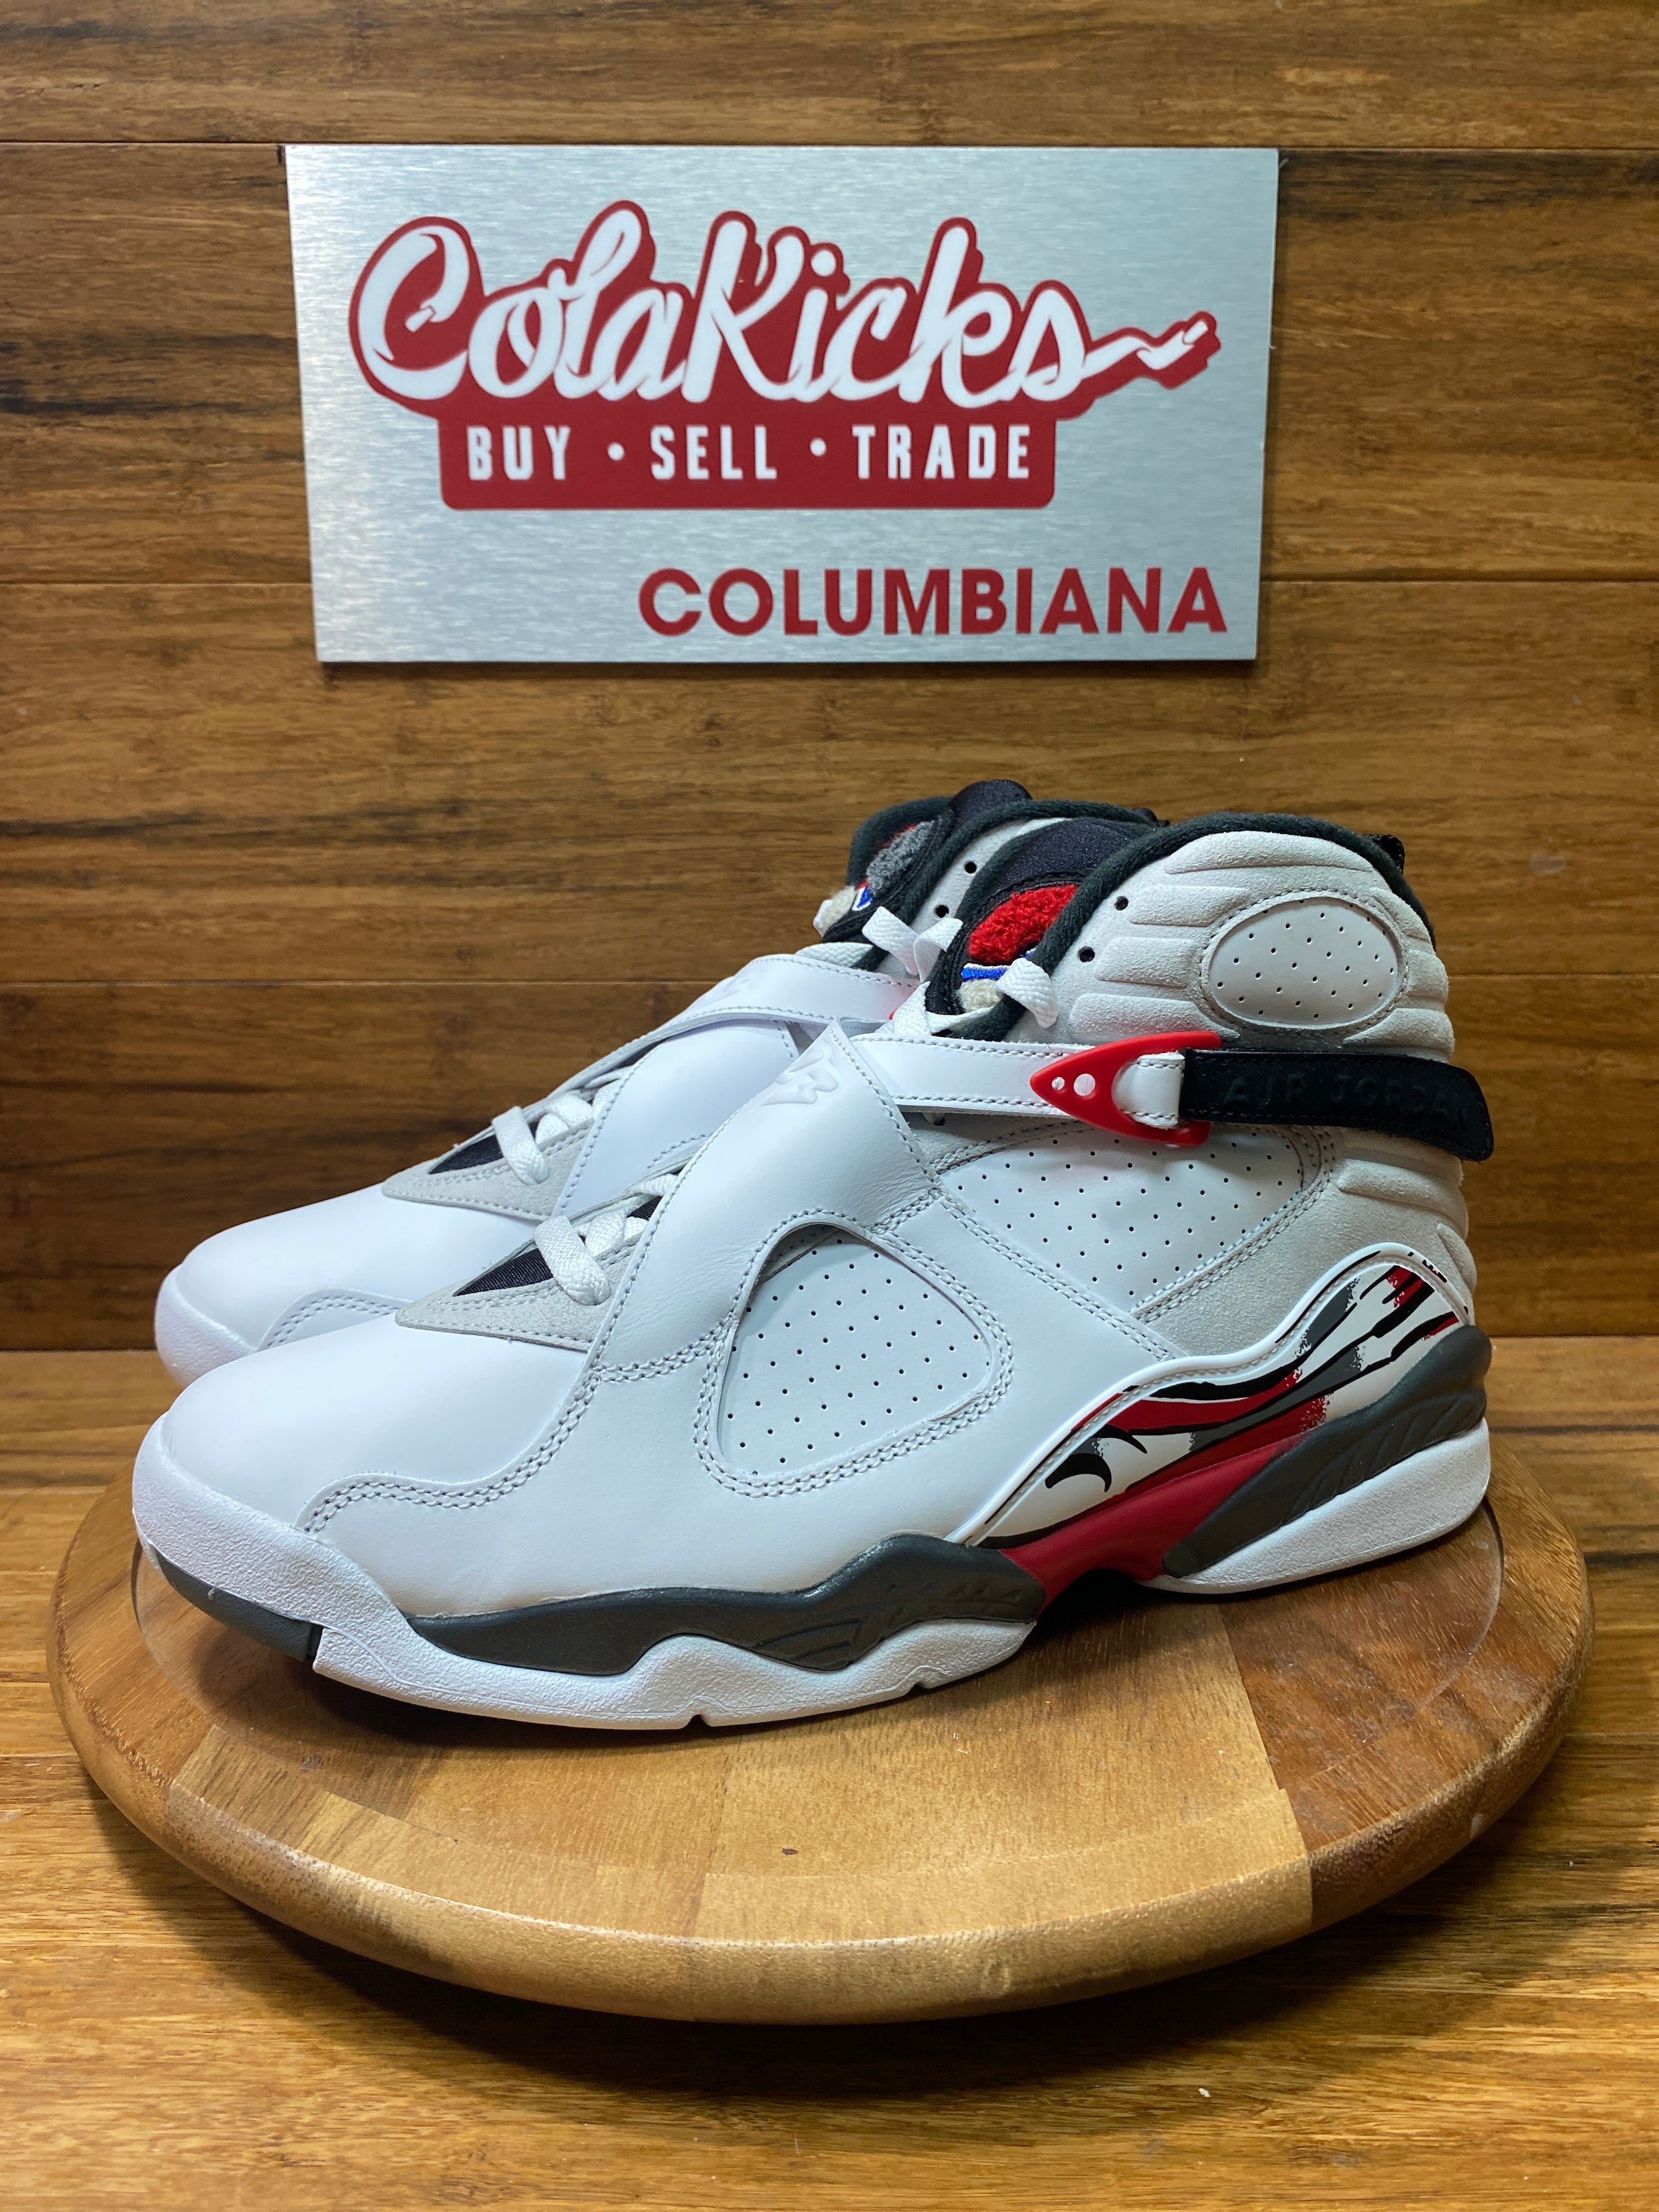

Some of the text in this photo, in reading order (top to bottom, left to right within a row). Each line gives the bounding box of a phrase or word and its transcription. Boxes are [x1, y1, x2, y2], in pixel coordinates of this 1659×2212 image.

[350, 201, 1219, 413] ColaKicks
[467, 425, 1031, 481] BUY SELL TRADE
[639, 567, 1227, 636] COLUMBIANA
